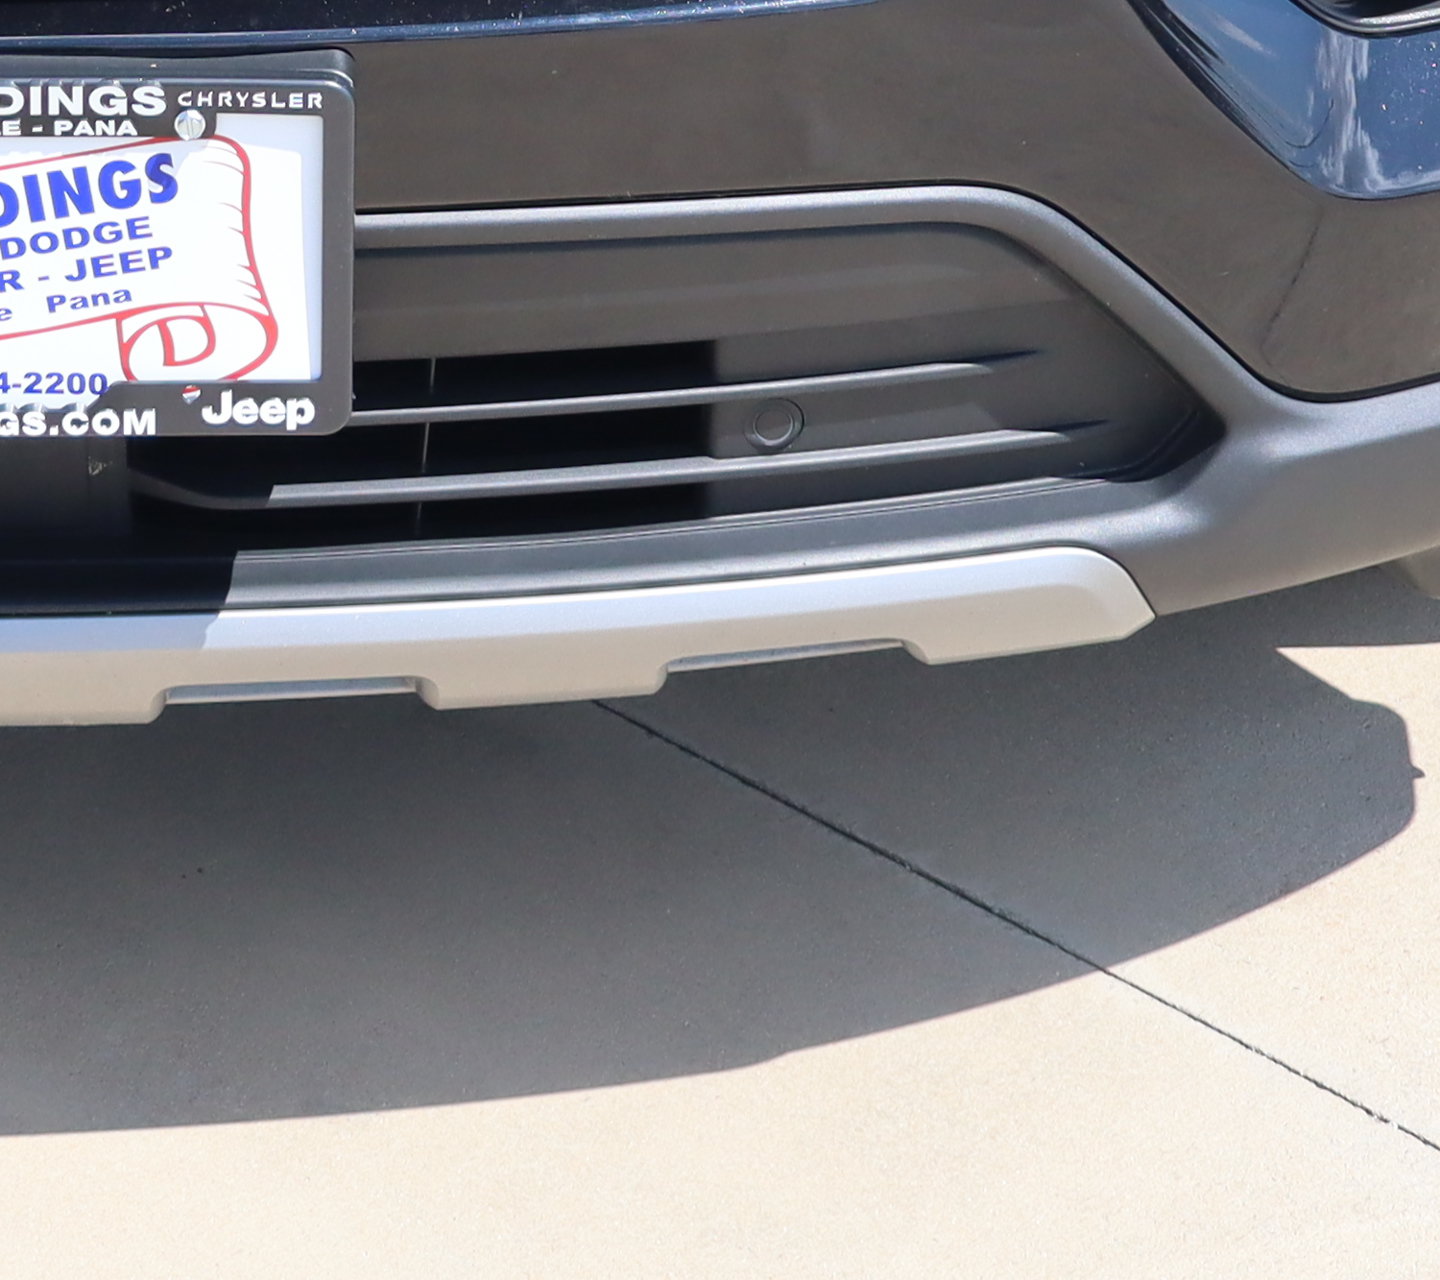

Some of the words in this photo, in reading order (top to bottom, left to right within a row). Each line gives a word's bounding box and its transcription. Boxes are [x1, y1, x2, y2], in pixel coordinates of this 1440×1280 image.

[177, 90, 324, 110] CHRYSLER
[53, 118, 139, 137] PANA
[64, 246, 174, 283] JEEP
[46, 286, 133, 314] Pana
[201, 388, 316, 431] Jeep
